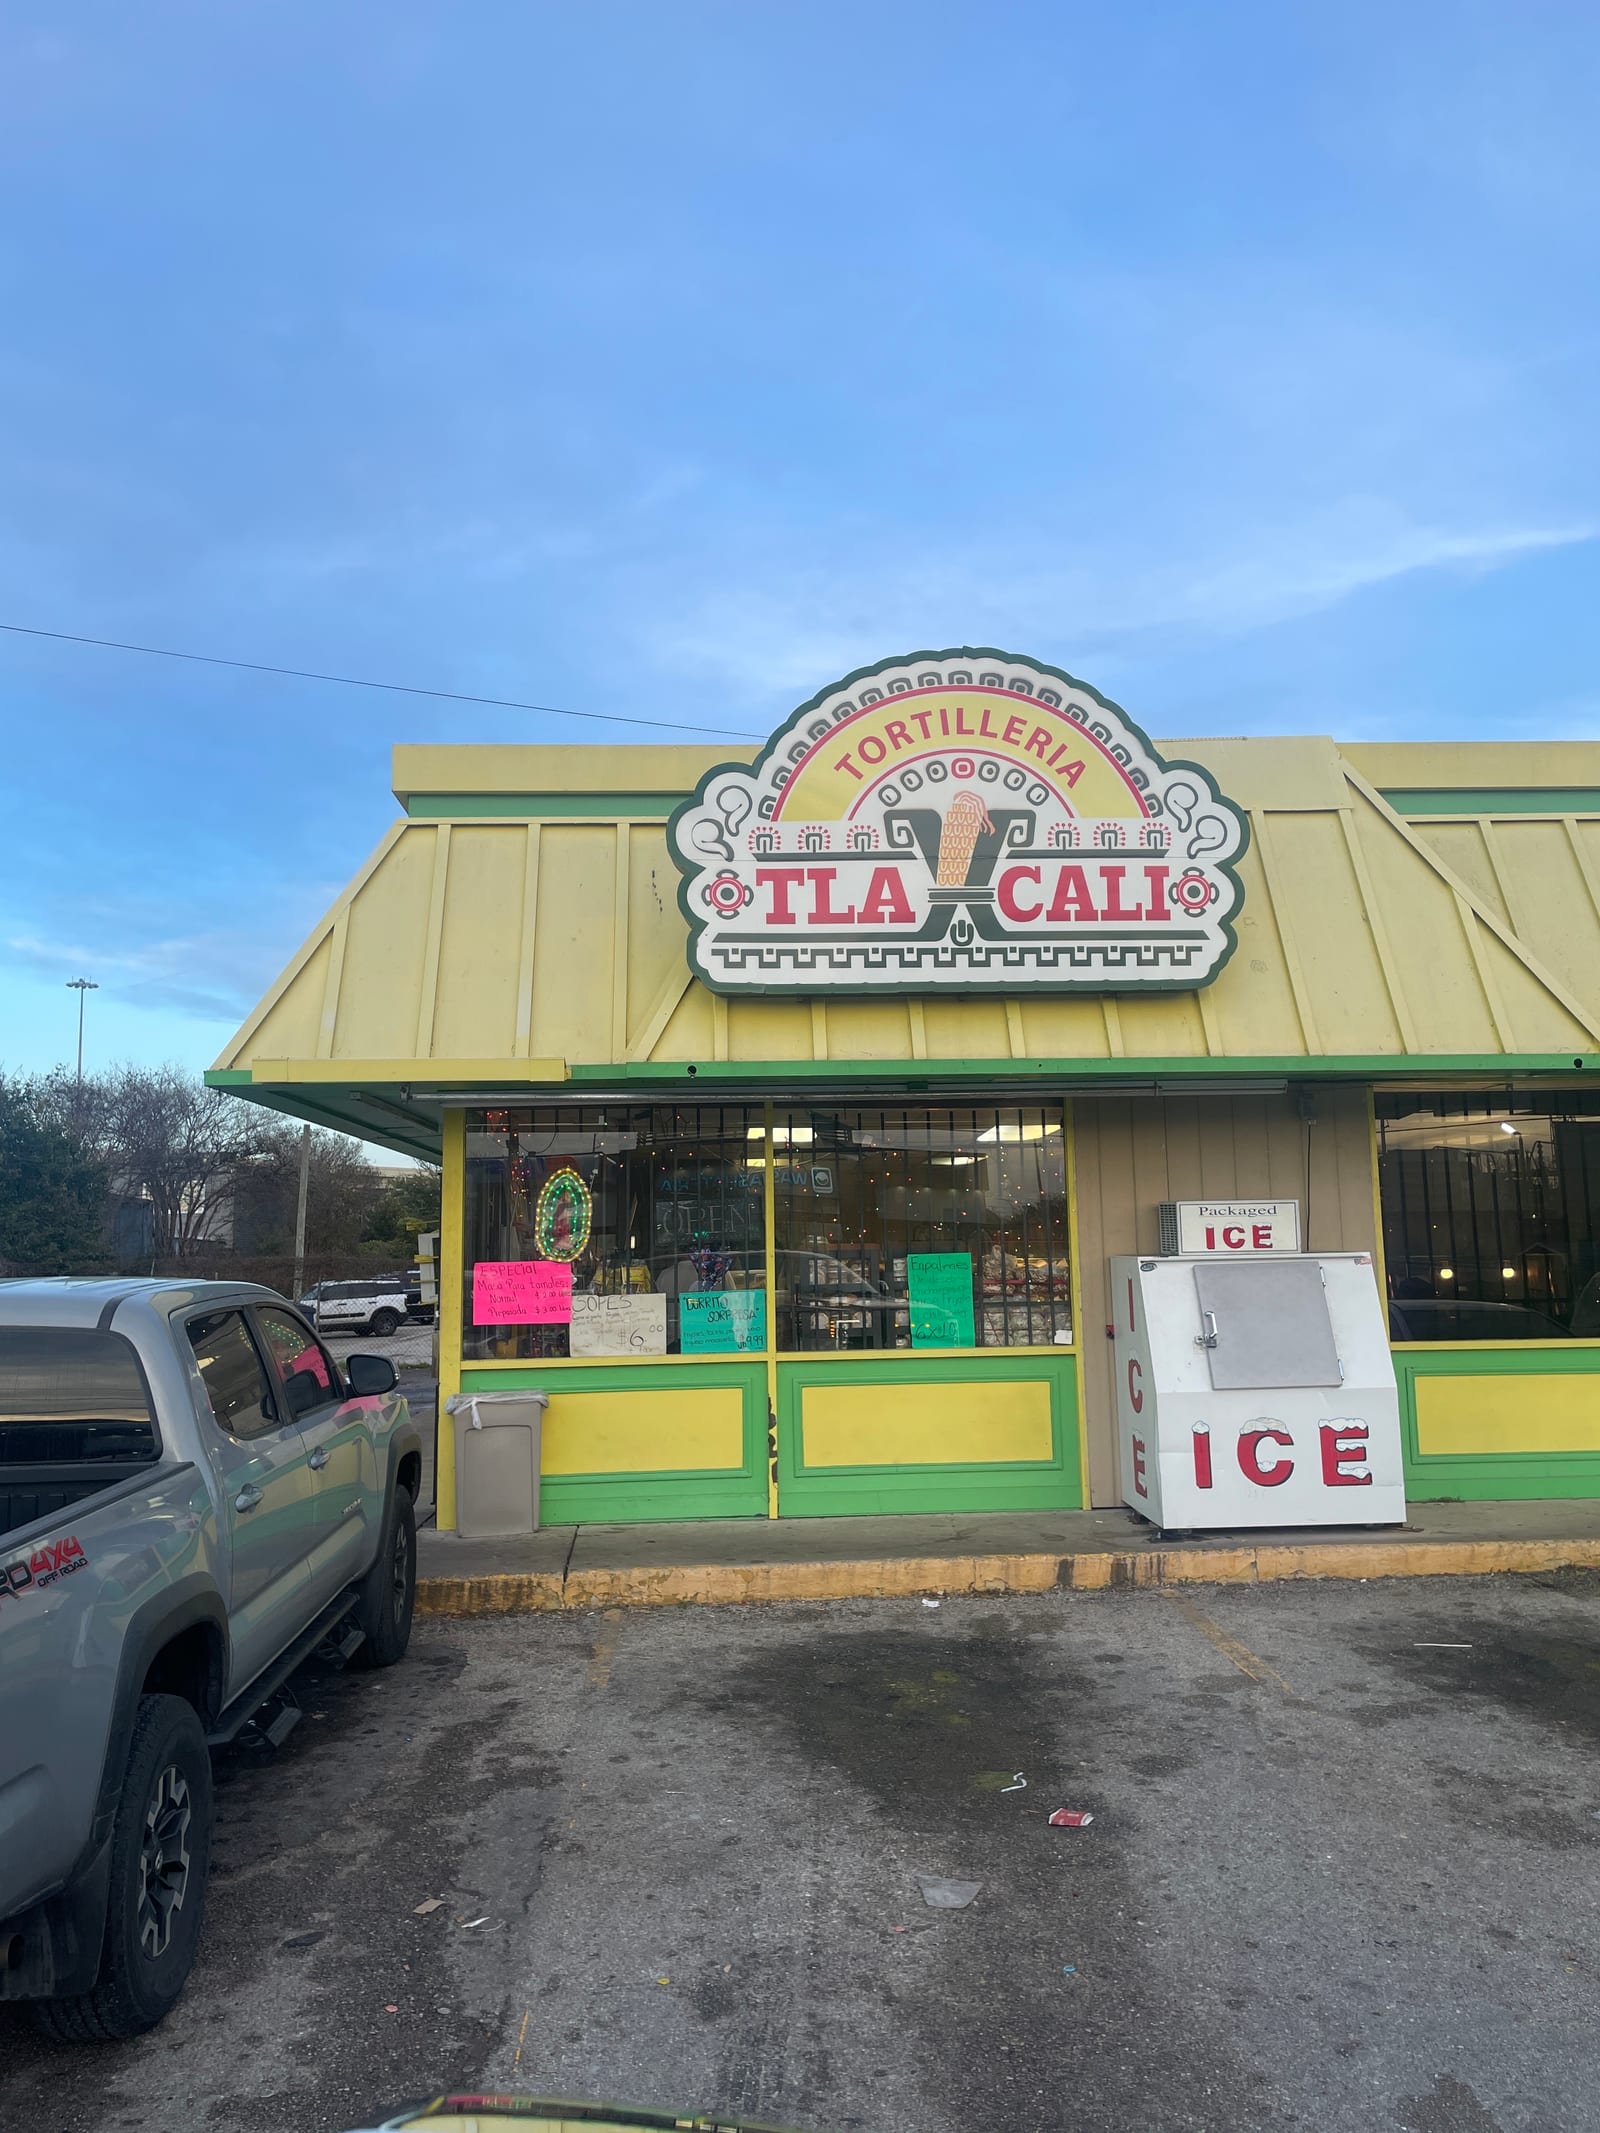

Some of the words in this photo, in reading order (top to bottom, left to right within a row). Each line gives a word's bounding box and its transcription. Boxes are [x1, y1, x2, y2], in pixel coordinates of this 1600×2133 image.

[834, 708, 1087, 790] TORTILLERIA
[756, 867, 916, 924] TLA
[998, 865, 1171, 923] CALI
[1199, 1205, 1278, 1217] Packaged
[1205, 1222, 1273, 1249] ICE
[572, 1295, 632, 1312] SOPES
[1127, 1275, 1148, 1499] ICE
[1192, 1417, 1373, 1489] ICE
[37, 1570, 59, 1588] OFF
[59, 1557, 88, 1577] ROAD
